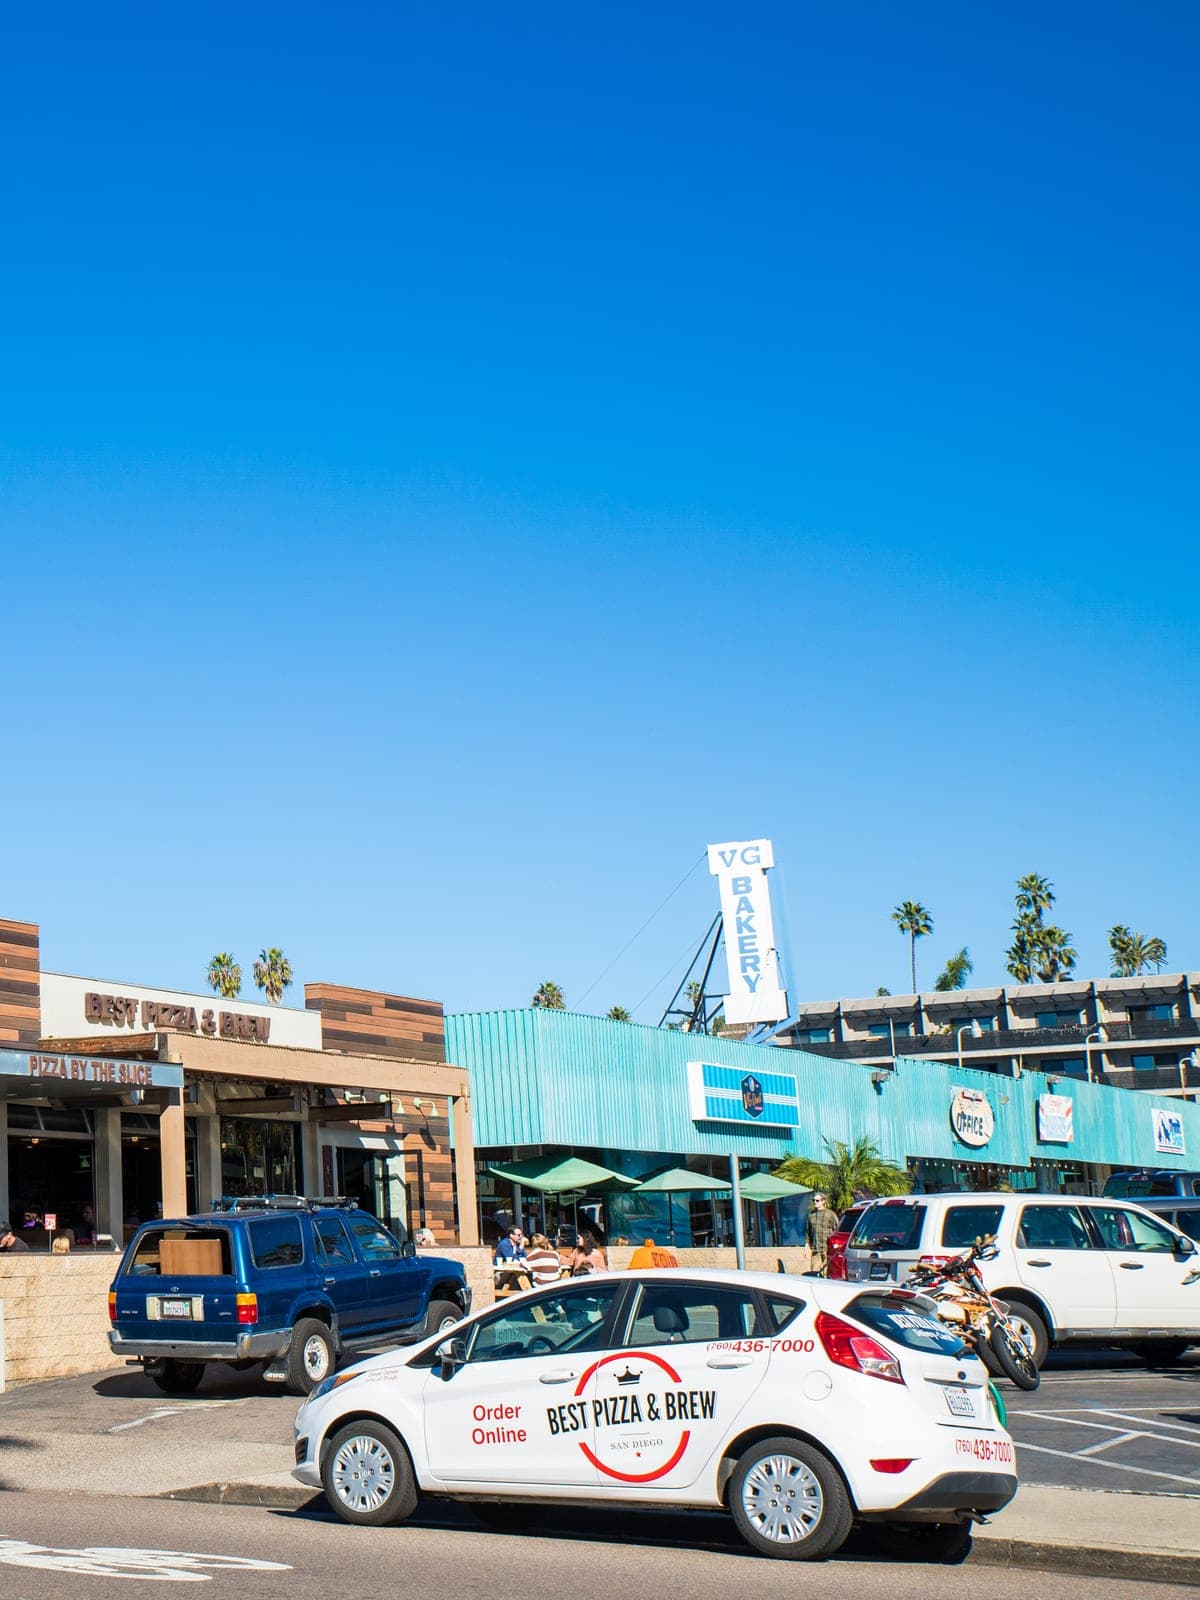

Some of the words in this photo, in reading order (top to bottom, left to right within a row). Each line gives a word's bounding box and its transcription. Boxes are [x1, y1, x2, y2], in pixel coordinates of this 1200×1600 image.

[718, 845, 761, 868] VG
[731, 876, 761, 993] BAKERY
[84, 992, 139, 1026] BEST
[141, 1001, 199, 1030] PIZZA
[201, 1008, 217, 1034] &
[219, 1011, 271, 1041] BREW
[29, 1055, 67, 1078] PIZZA
[70, 1058, 87, 1080] BY
[91, 1060, 116, 1082] THE
[119, 1063, 152, 1084] SLICE
[957, 1111, 983, 1136] OFFICE
[732, 1339, 815, 1353] 436-7000
[473, 1404, 521, 1422] Order
[547, 1401, 589, 1435] BEST
[593, 1395, 642, 1427] PIZZA
[647, 1394, 661, 1421] &
[665, 1390, 718, 1420] BREW
[472, 1426, 527, 1445] Online
[610, 1441, 631, 1451] SAN
[633, 1438, 664, 1449] DIEGO
[973, 1439, 1012, 1463] 436-7000
